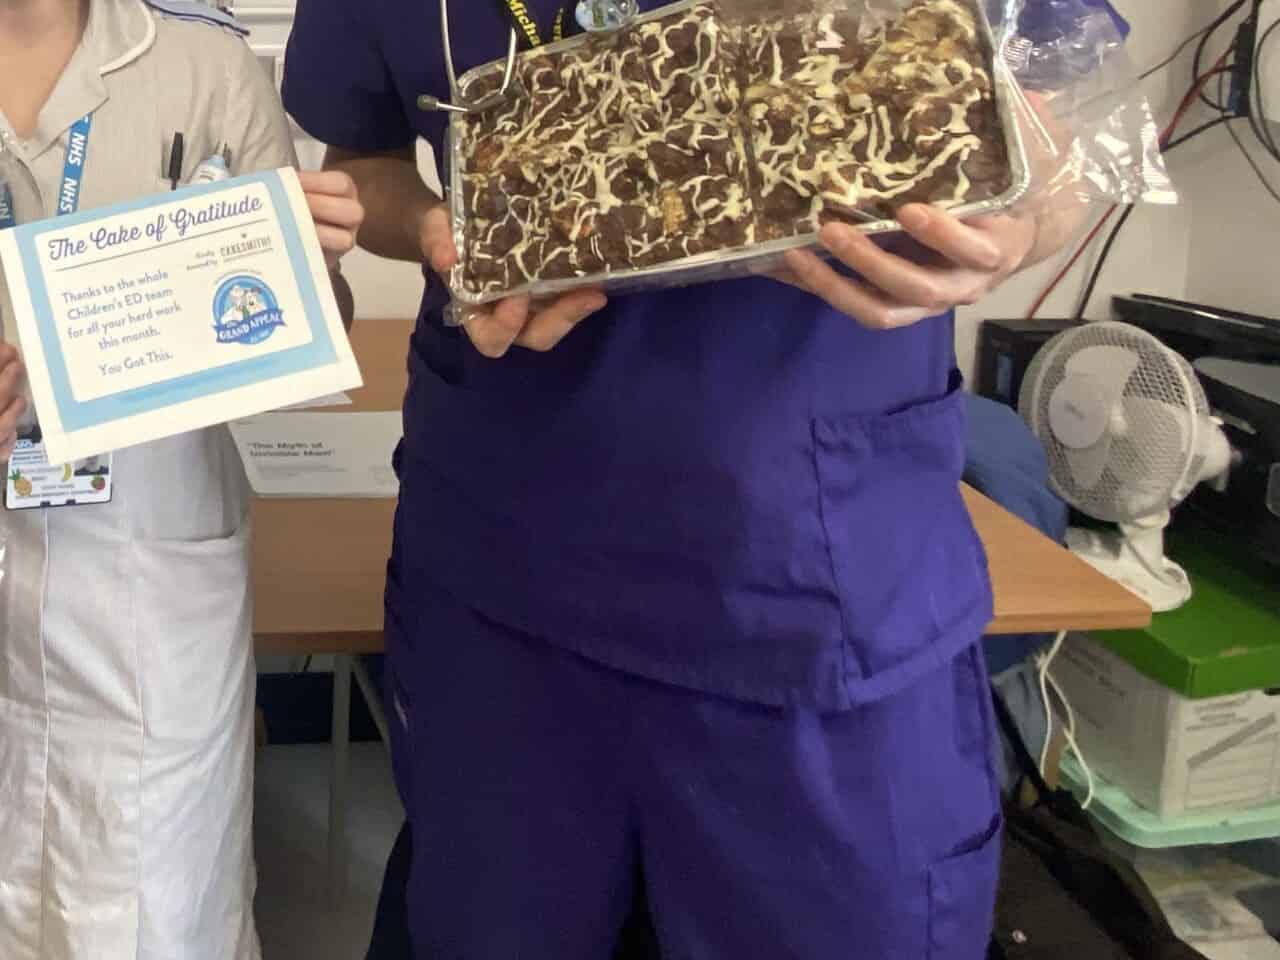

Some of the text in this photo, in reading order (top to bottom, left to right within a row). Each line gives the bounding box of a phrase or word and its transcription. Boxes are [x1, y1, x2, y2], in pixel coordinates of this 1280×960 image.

[68, 132, 86, 166] NHS
[60, 177, 78, 214] NHS
[48, 197, 263, 261] The Cake of Gratitude
[63, 269, 169, 304] Thanks to the whole
[67, 288, 174, 320] Children's ED team
[67, 300, 182, 339] for all your hard work
[98, 326, 161, 350] this month.
[219, 324, 250, 340] GRAND
[98, 350, 174, 376] You Got This.
